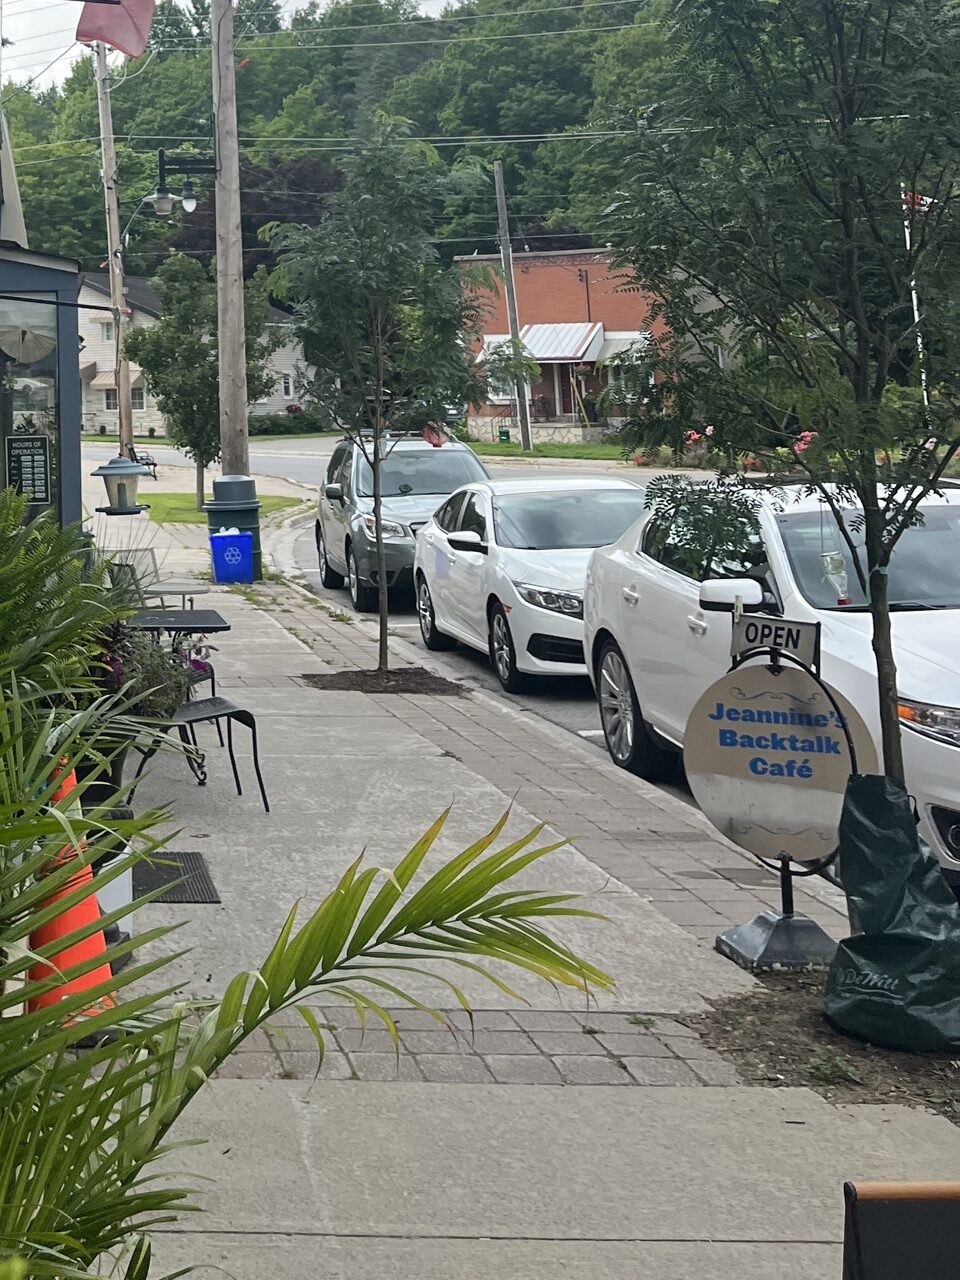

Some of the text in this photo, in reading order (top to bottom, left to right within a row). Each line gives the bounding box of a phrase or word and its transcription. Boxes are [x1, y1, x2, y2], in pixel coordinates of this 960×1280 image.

[744, 622, 801, 650] OPEN
[718, 728, 842, 756] Backtalk
[749, 757, 814, 779] Café
